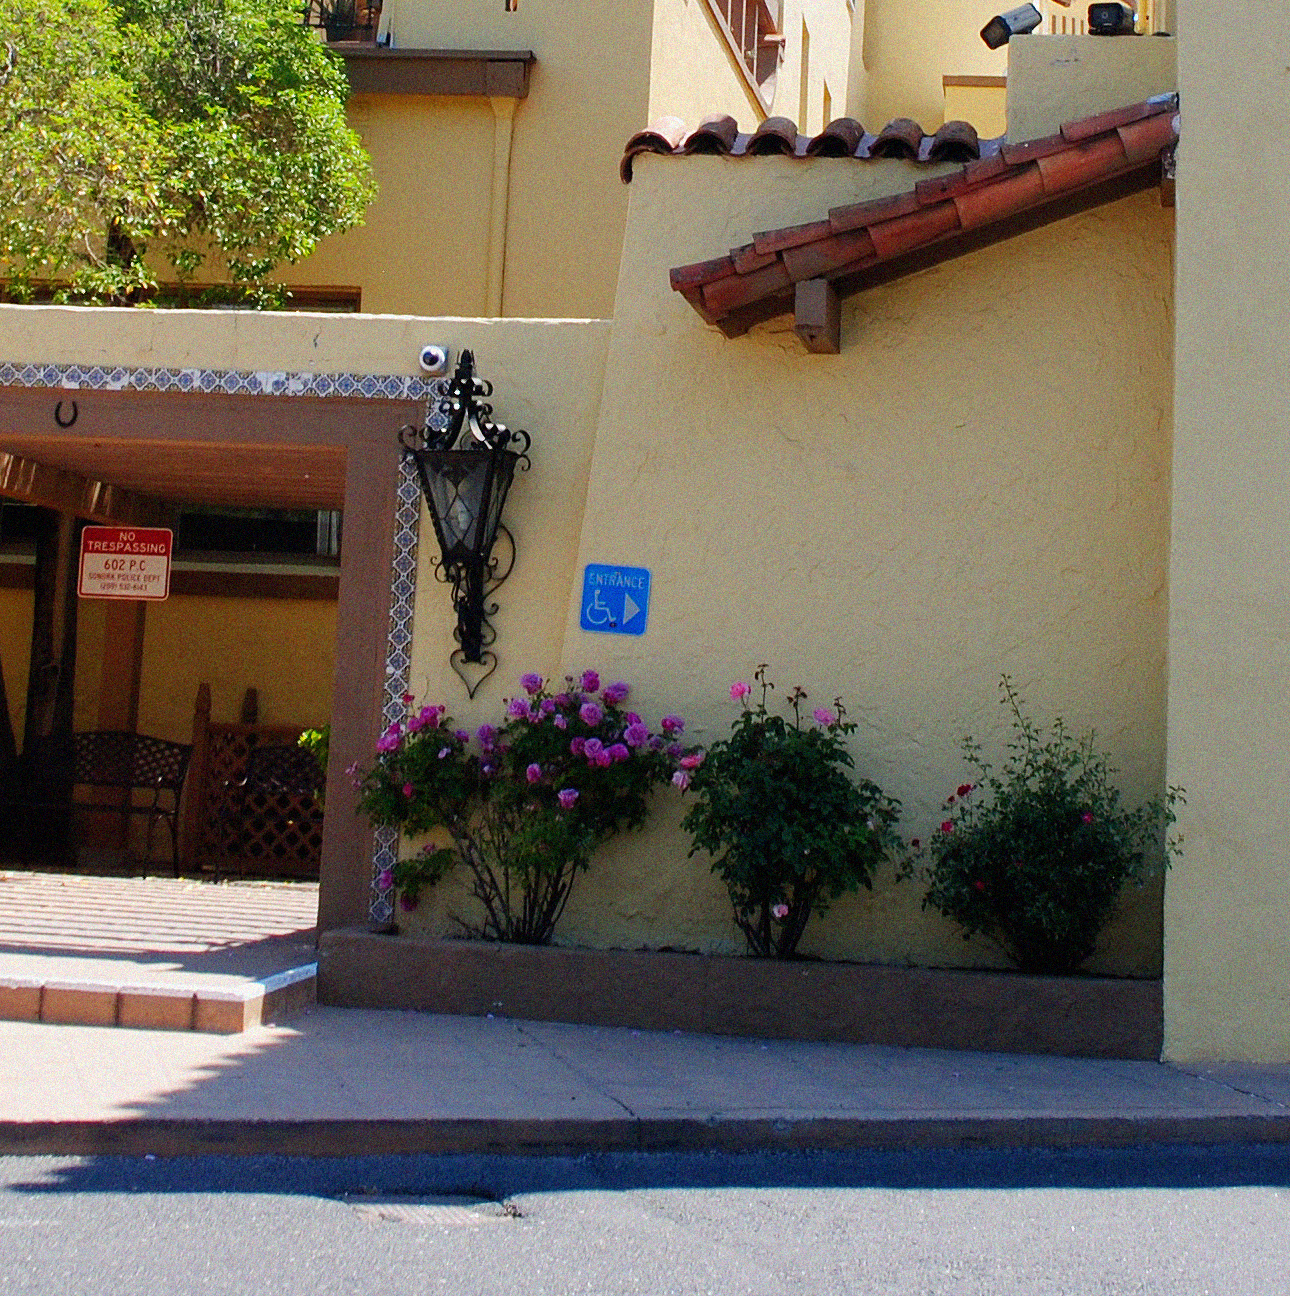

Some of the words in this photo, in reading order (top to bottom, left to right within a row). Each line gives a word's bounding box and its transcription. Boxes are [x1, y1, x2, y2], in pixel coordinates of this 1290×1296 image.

[119, 531, 136, 542] NO
[87, 540, 167, 554] TRESPASSING
[103, 559, 126, 571] 602
[588, 572, 646, 590] ENTRANCE
